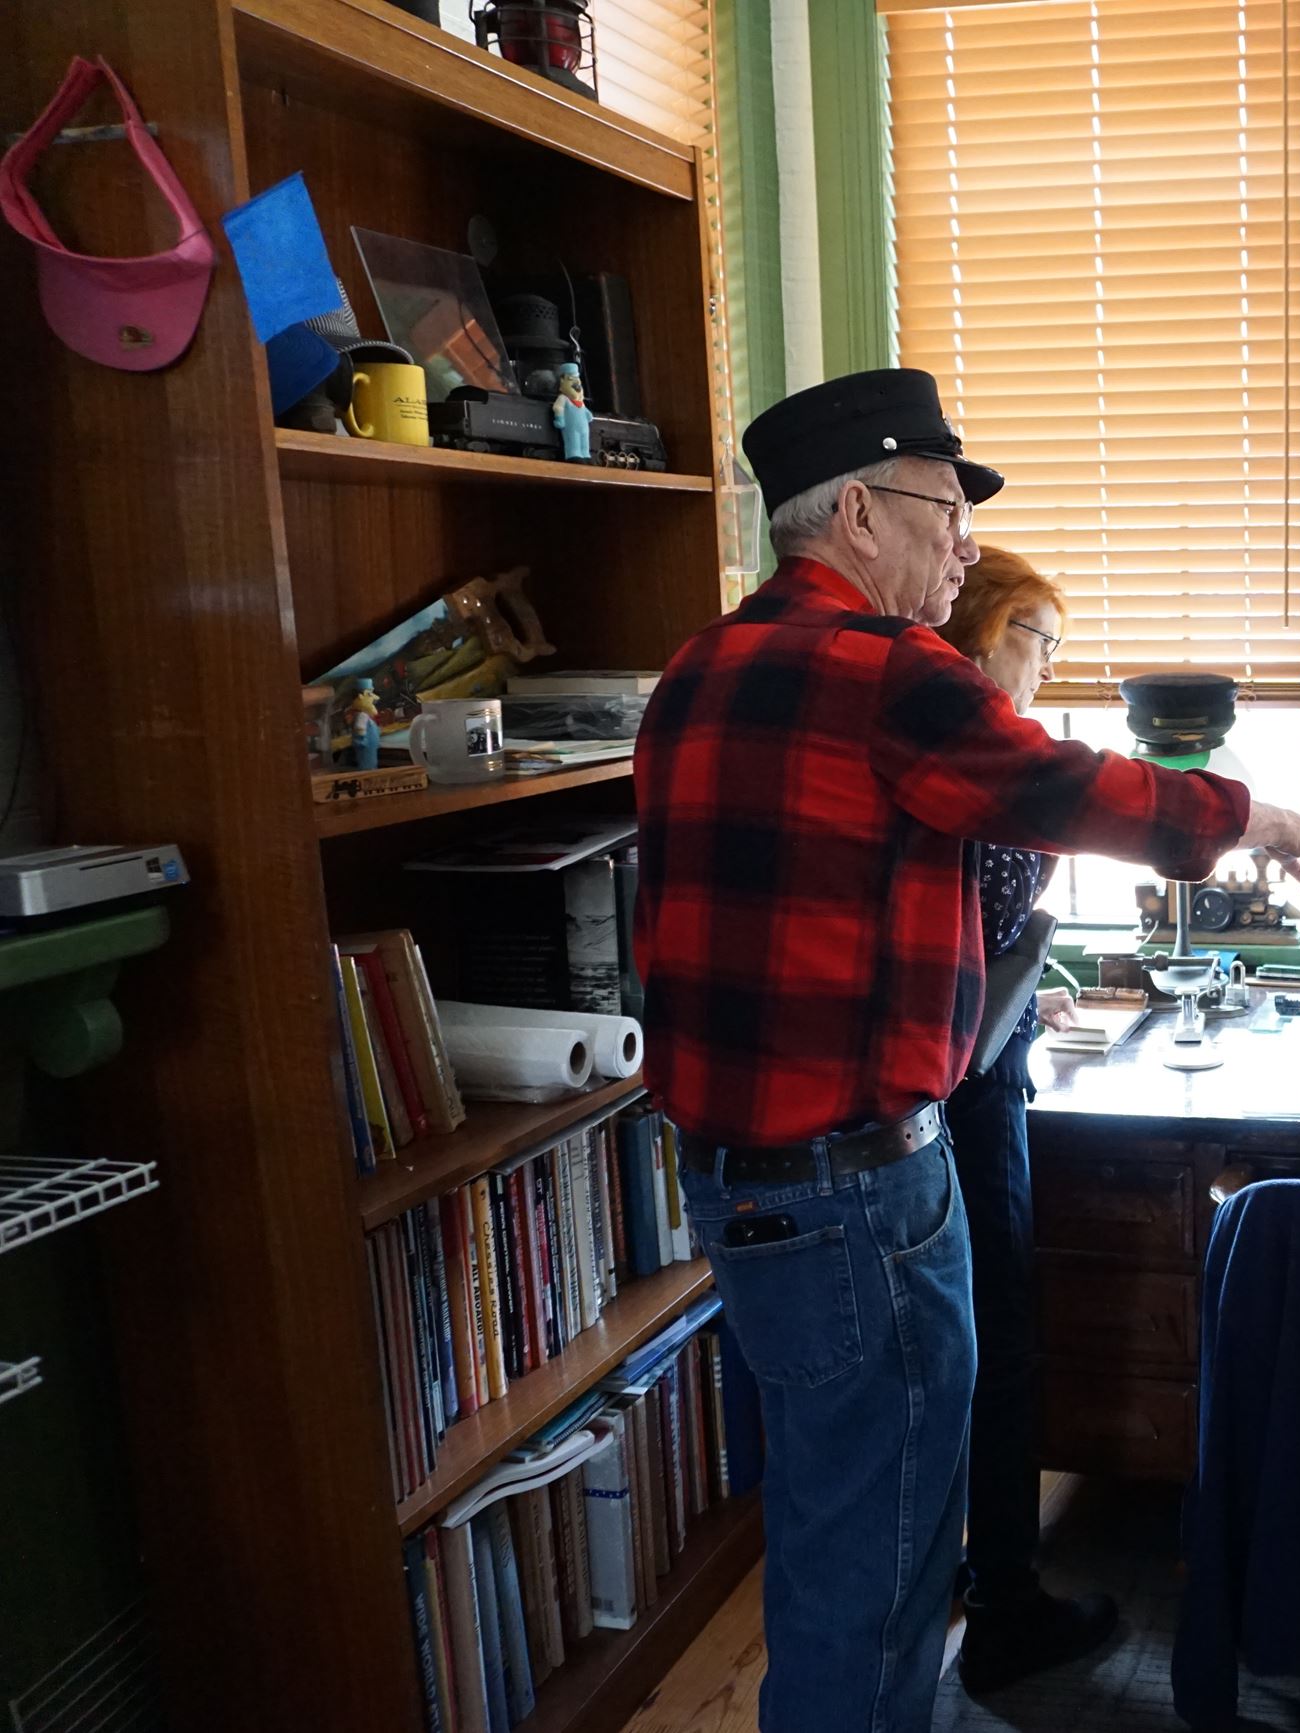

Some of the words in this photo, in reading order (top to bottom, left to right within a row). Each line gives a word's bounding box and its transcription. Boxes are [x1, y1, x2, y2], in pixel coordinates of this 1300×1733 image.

[471, 1264, 479, 1282] ALL
[474, 1286, 484, 1335] ABOARD!
[490, 1300, 499, 1340] Road
[416, 1593, 428, 1638] WIDE
[421, 1639, 436, 1699] WORLD
